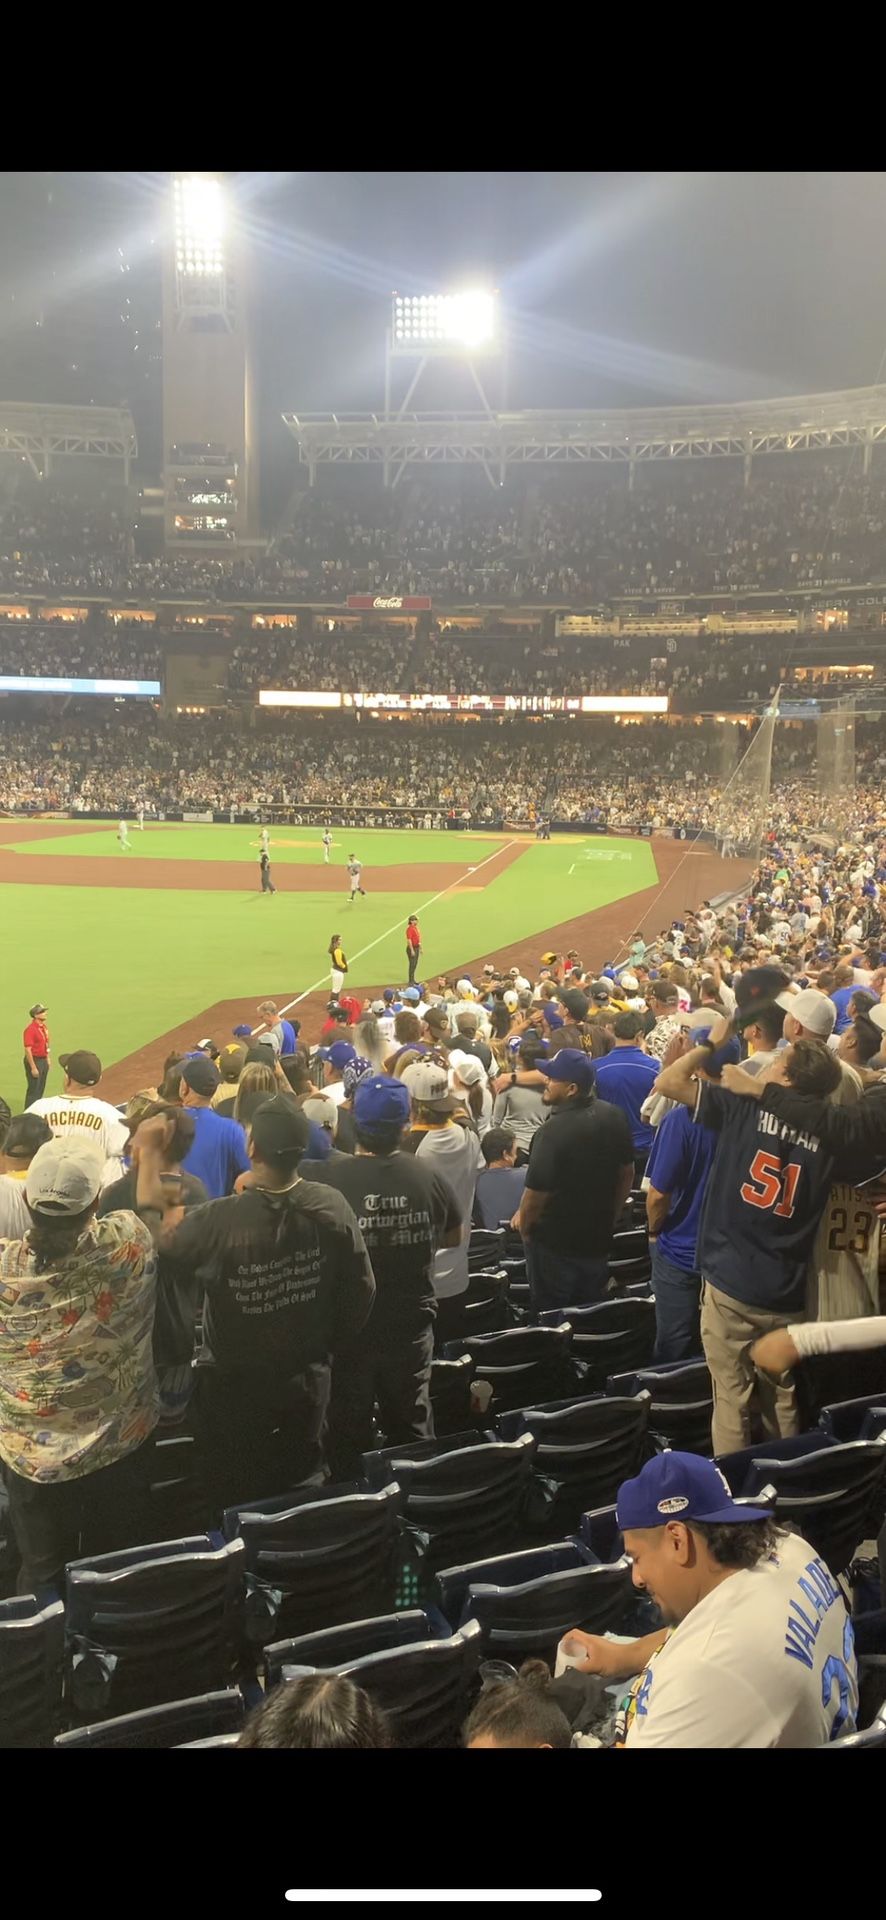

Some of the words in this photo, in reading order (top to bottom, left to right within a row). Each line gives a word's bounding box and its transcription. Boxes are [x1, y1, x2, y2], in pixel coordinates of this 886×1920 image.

[740, 1149, 801, 1218] 51
[358, 1208, 431, 1230] orwegian
[363, 1194, 408, 1211] True
[828, 1208, 873, 1253] 23
